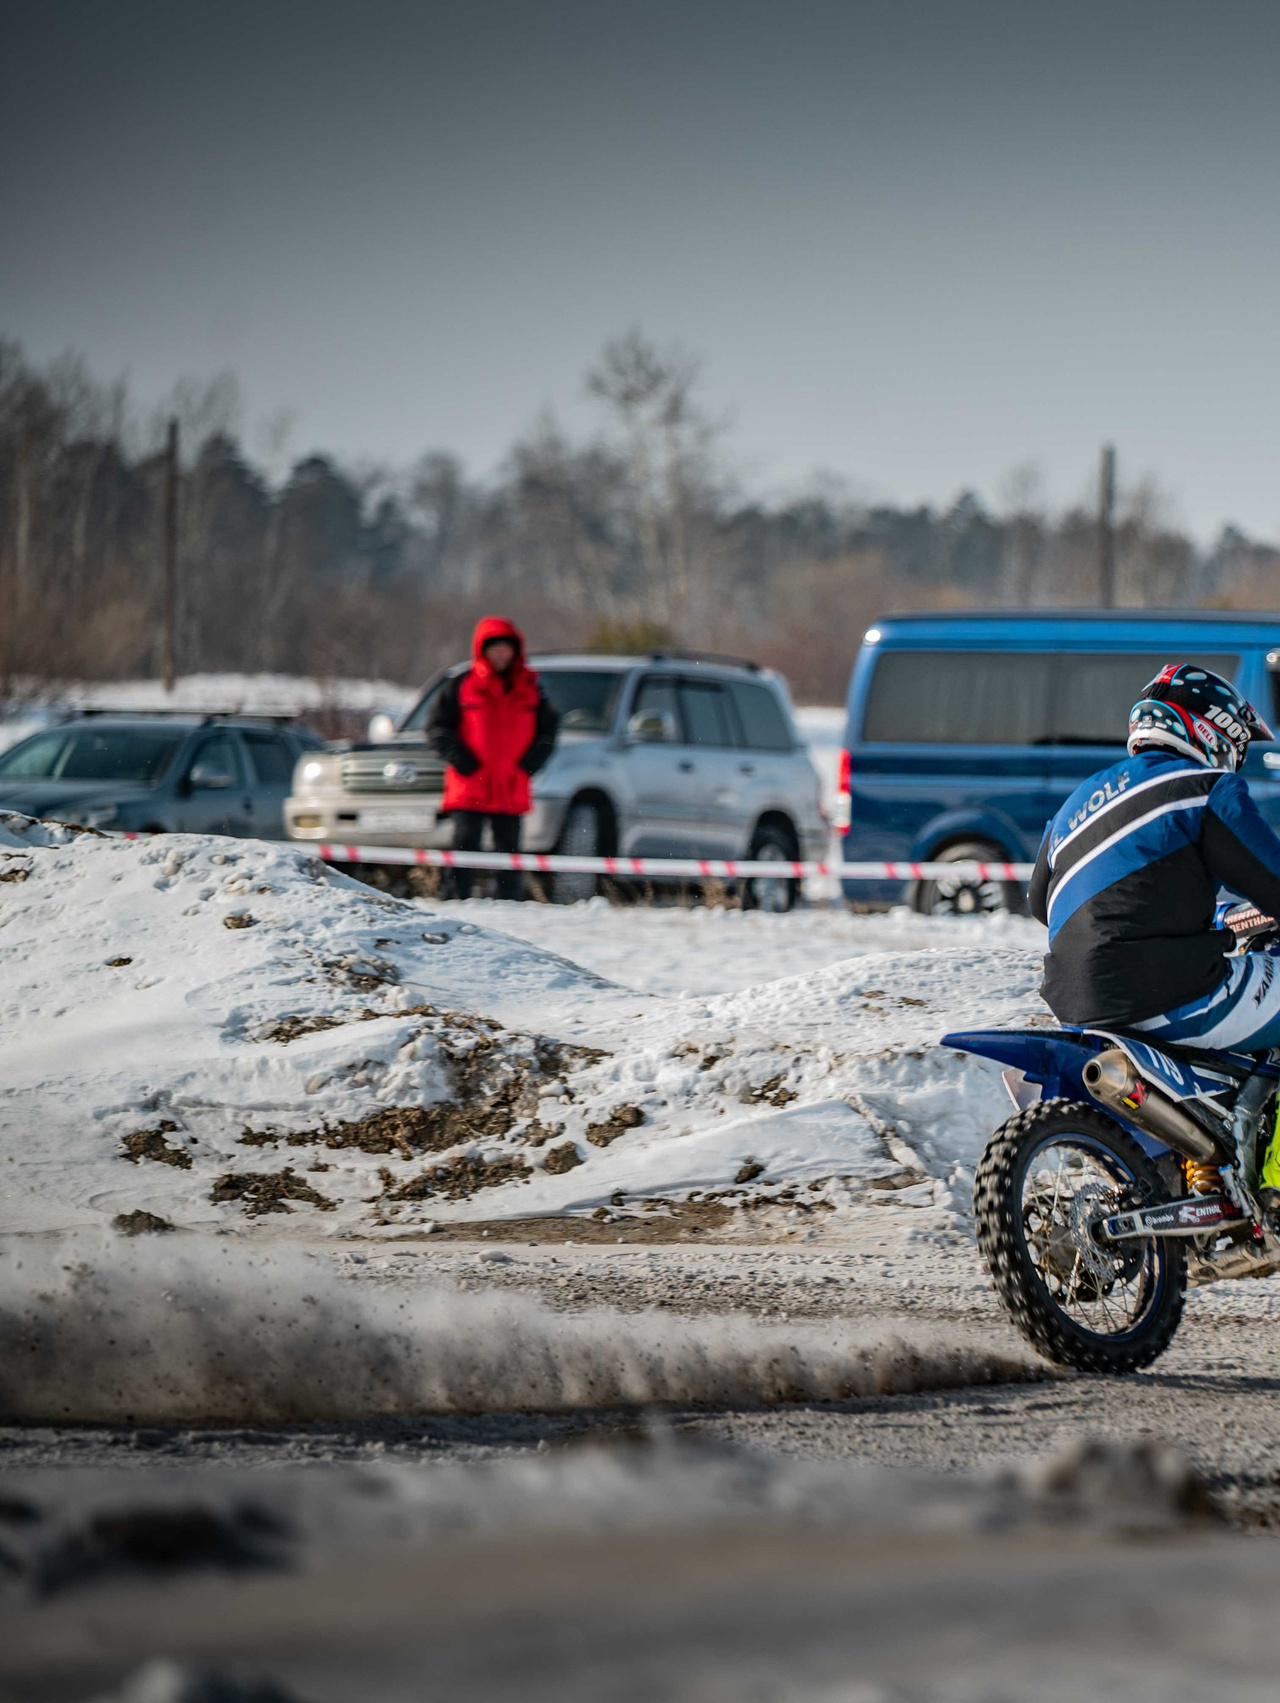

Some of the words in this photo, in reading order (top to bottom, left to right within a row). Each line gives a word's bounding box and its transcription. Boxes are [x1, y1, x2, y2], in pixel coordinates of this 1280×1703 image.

[1197, 722, 1216, 745] BELL
[1203, 704, 1251, 752] 100%
[1067, 770, 1130, 832] WOLF
[1178, 1204, 1222, 1223] RENTHAL
